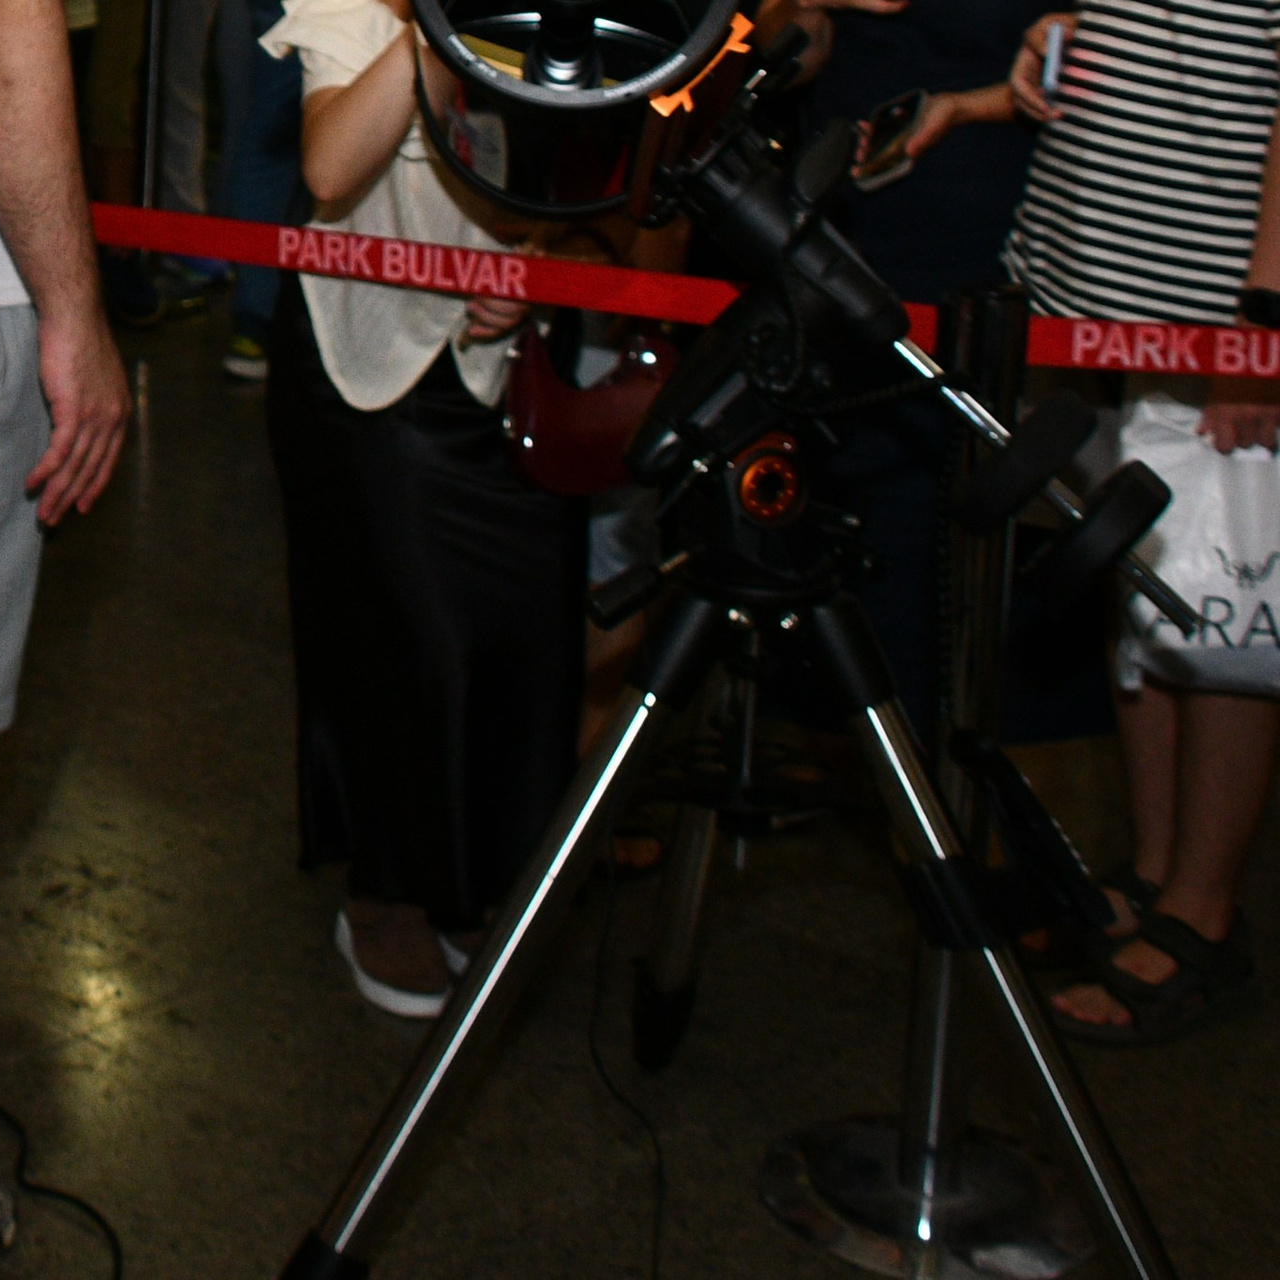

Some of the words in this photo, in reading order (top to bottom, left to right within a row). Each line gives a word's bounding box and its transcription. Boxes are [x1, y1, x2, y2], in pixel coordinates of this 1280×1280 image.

[278, 227, 374, 276] PARK
[381, 240, 527, 298] BULVAR
[1071, 322, 1201, 370] PARK
